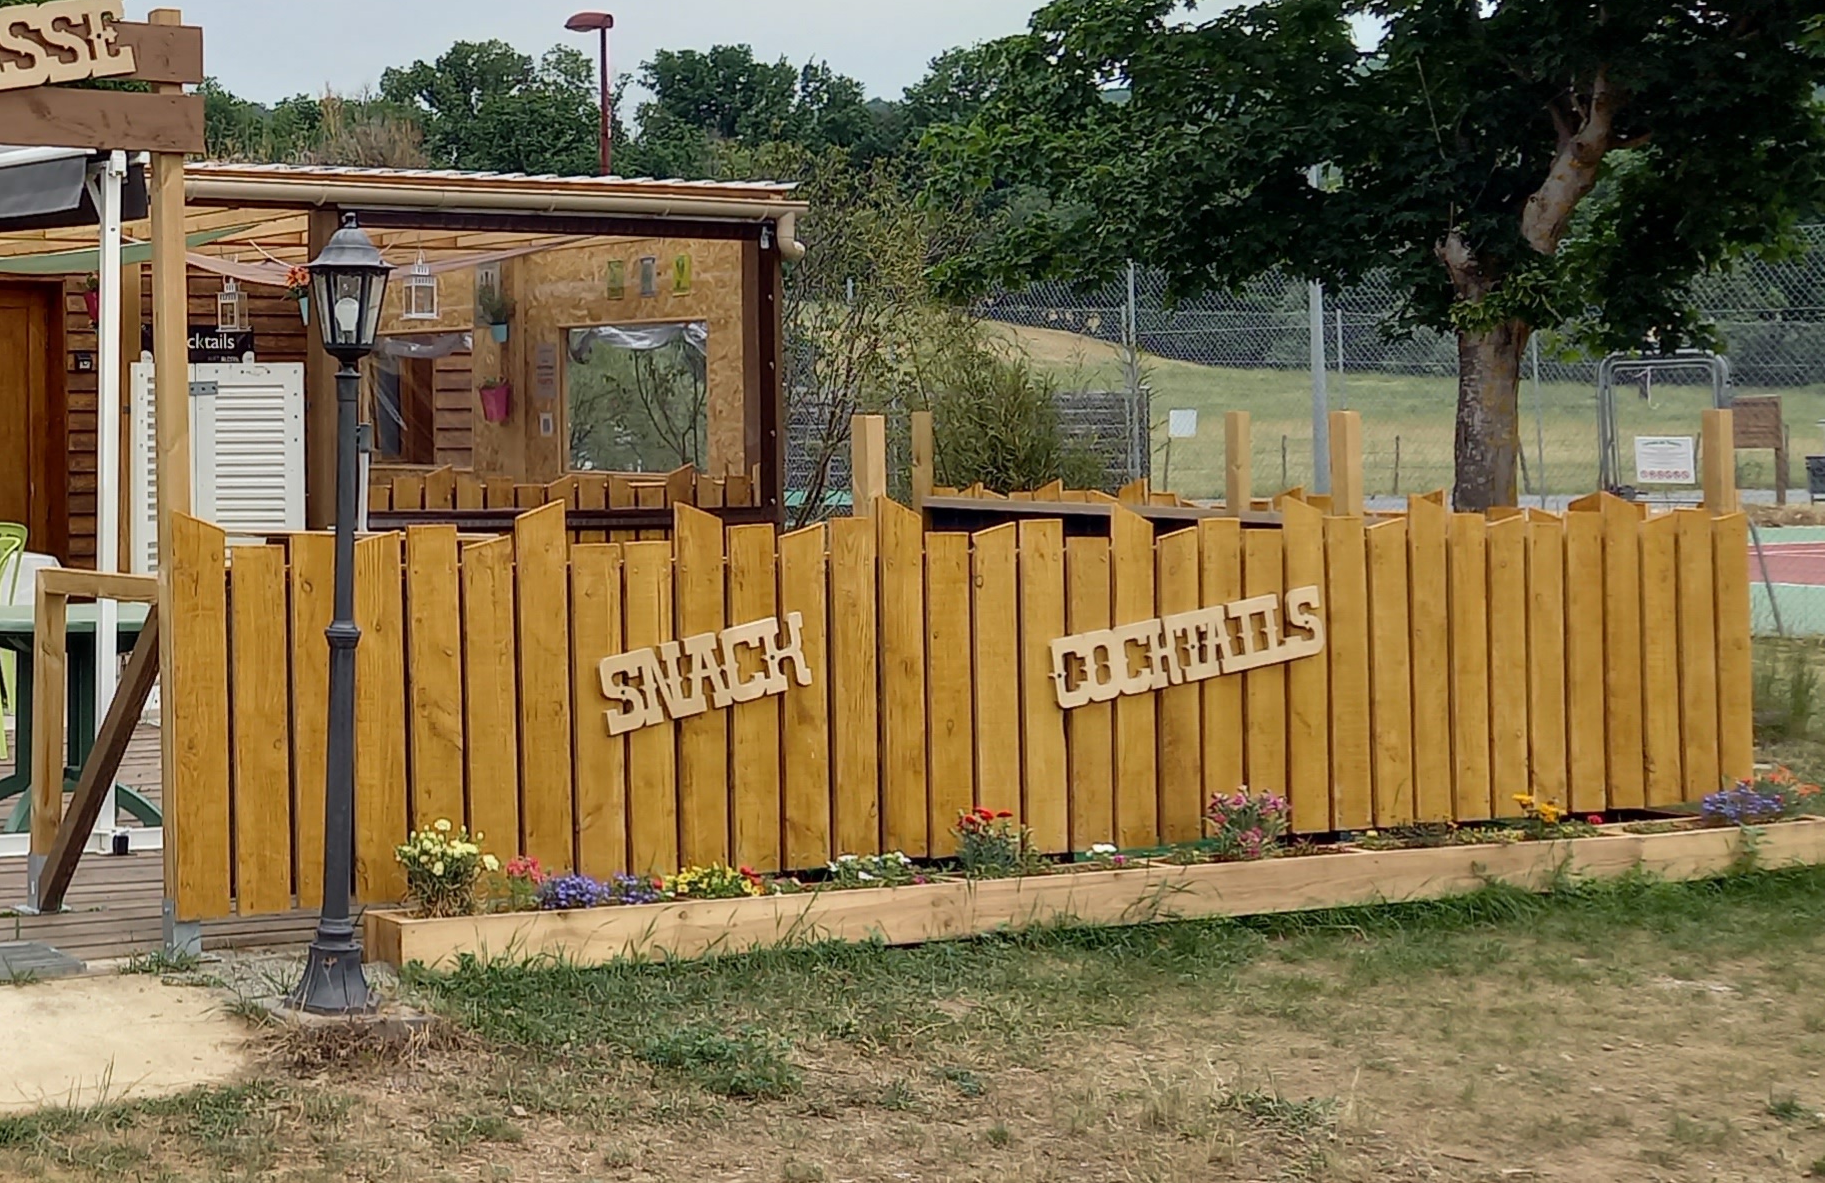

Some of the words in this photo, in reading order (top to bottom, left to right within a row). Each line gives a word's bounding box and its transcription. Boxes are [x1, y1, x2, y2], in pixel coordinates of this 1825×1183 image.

[187, 332, 235, 350] cktails
[599, 611, 812, 736] SNACK
[1048, 585, 1324, 708] COCKTAILS
